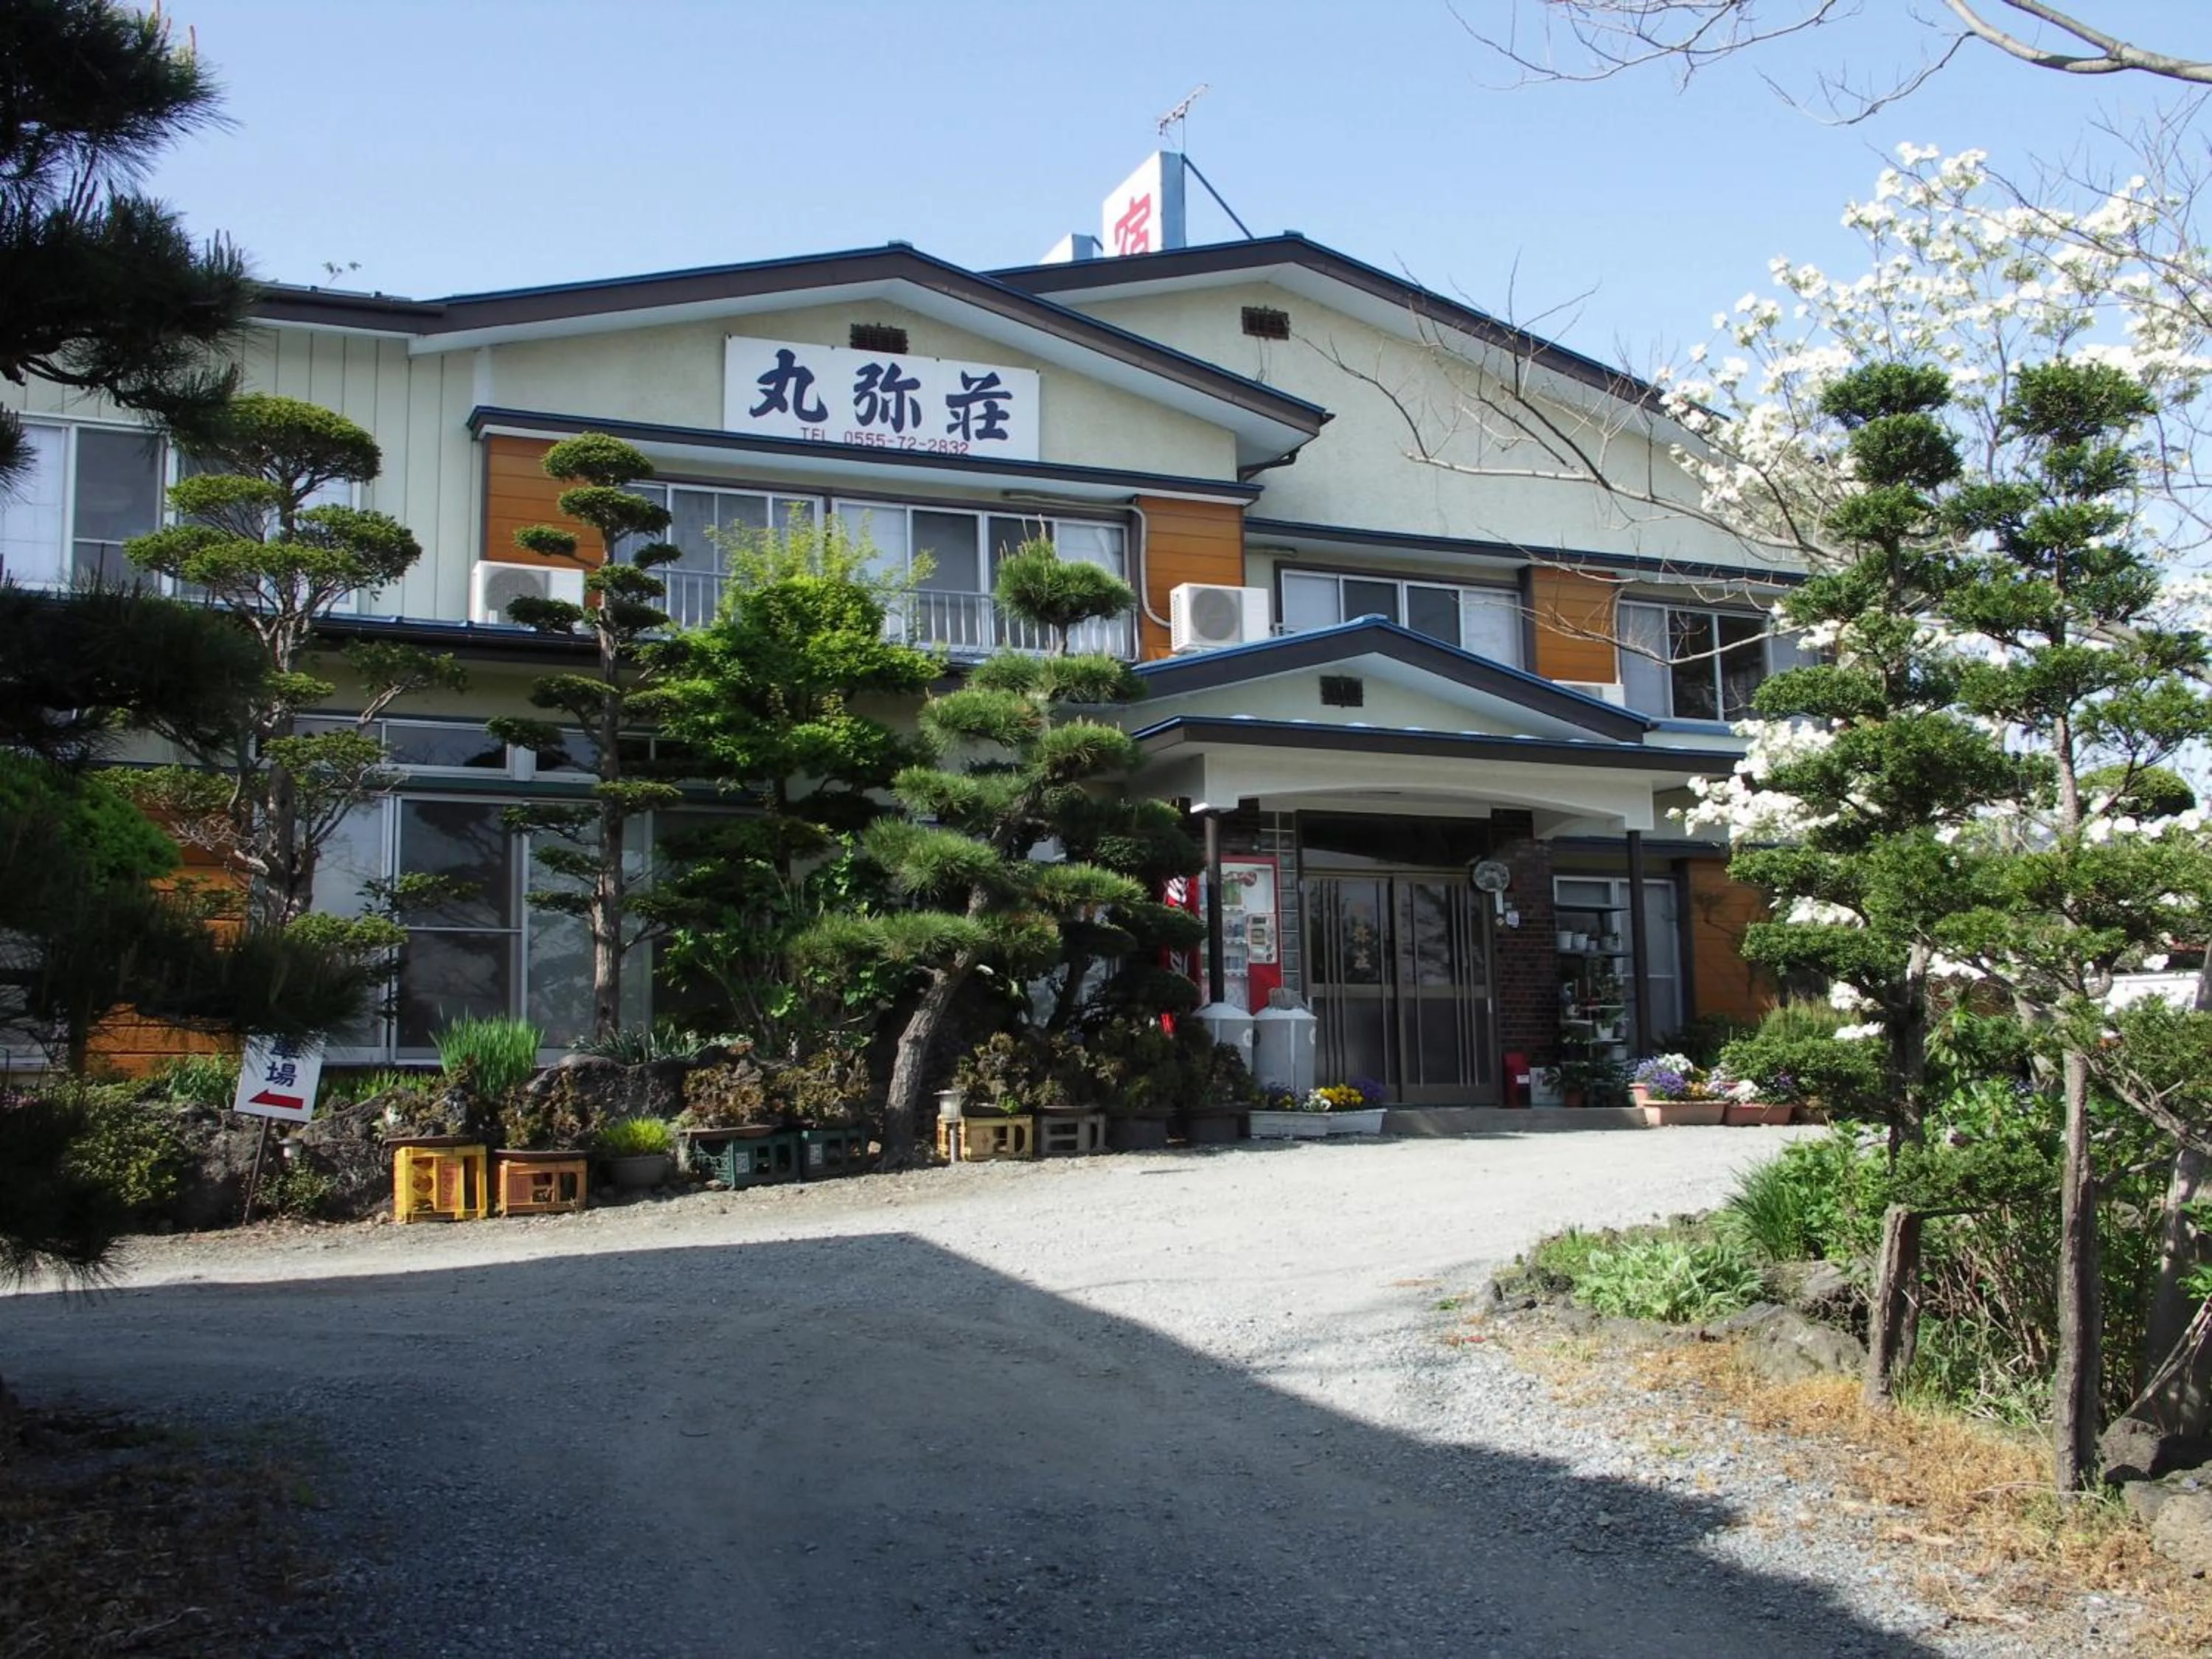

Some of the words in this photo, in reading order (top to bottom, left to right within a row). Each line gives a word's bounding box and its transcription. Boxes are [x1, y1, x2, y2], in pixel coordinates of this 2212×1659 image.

[749, 349, 1013, 441] 丸弥荘
[801, 426, 826, 441] TEL
[844, 431, 969, 455] 0555-72-2832
